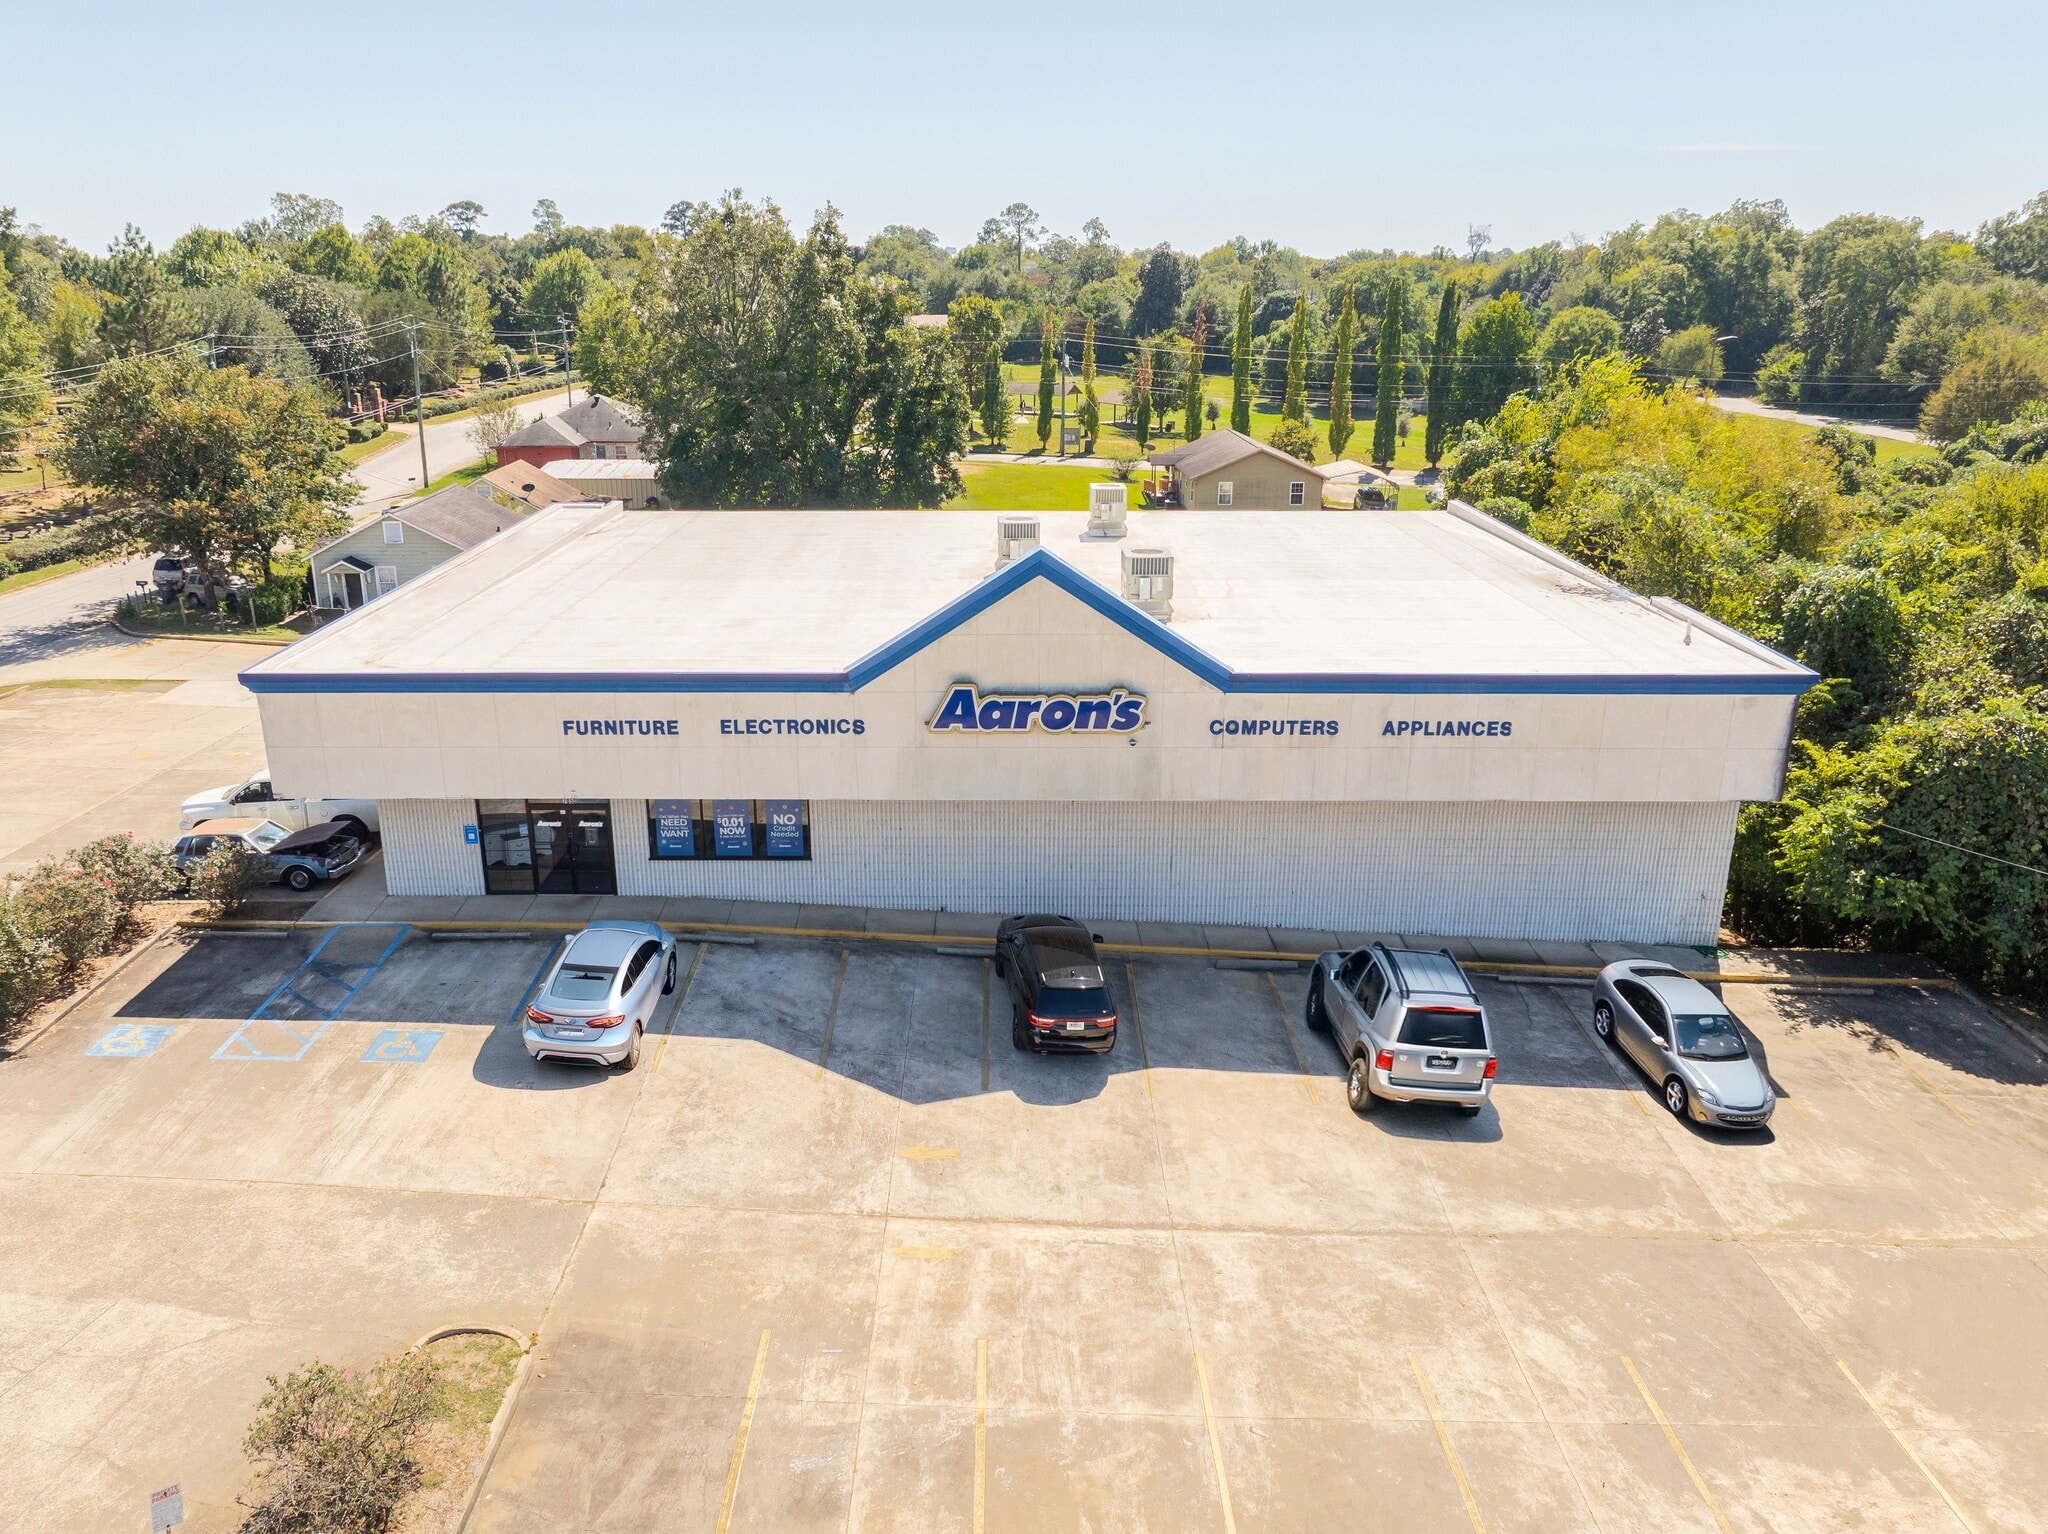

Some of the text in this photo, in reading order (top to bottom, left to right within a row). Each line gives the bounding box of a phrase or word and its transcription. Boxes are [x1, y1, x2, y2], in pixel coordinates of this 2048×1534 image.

[929, 685, 1148, 733] Aaron's
[563, 719, 866, 735] FURNITURE ELECTRONICS
[1209, 719, 1513, 737] COMPUTERS APPLIANCES
[660, 818, 688, 826] NEED
[717, 817, 744, 827] $0.01
[773, 814, 796, 825] NO
[719, 827, 746, 835] NOW
